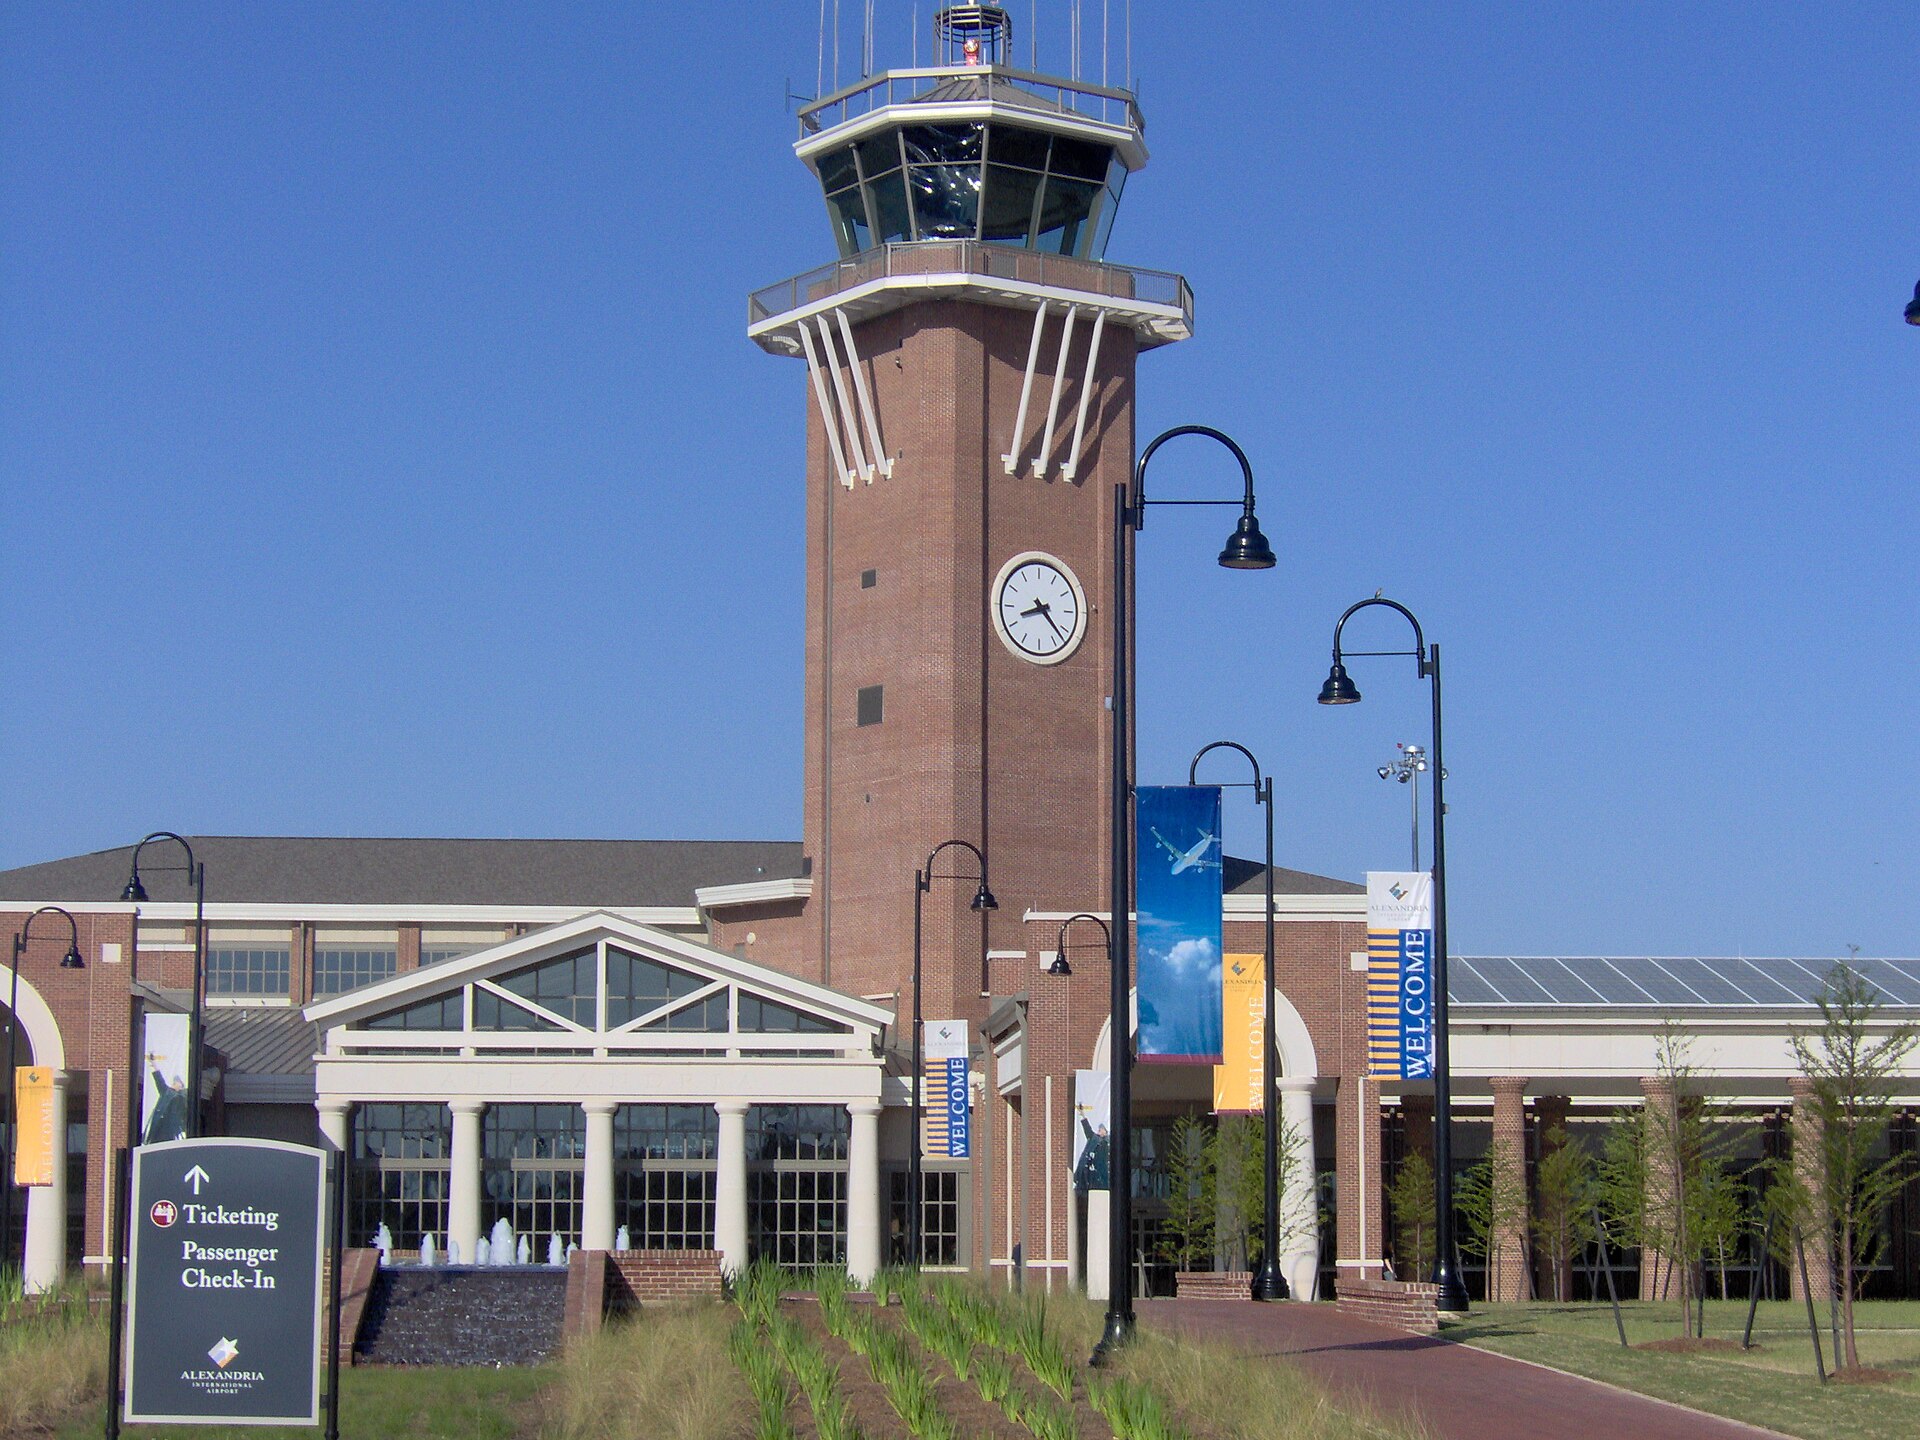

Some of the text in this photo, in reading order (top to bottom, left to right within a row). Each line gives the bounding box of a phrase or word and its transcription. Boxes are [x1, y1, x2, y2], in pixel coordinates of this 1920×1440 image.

[1370, 904, 1429, 912] ALEXANDRIA
[1405, 931, 1428, 1078] WELCOME
[1250, 996, 1264, 1110] WELCOME
[952, 1059, 966, 1157] WELCOME
[183, 1204, 279, 1231] Ticketing
[182, 1241, 279, 1267] Passenger
[182, 1268, 275, 1288] Check-In
[180, 1370, 265, 1381] ALEXANDRIA
